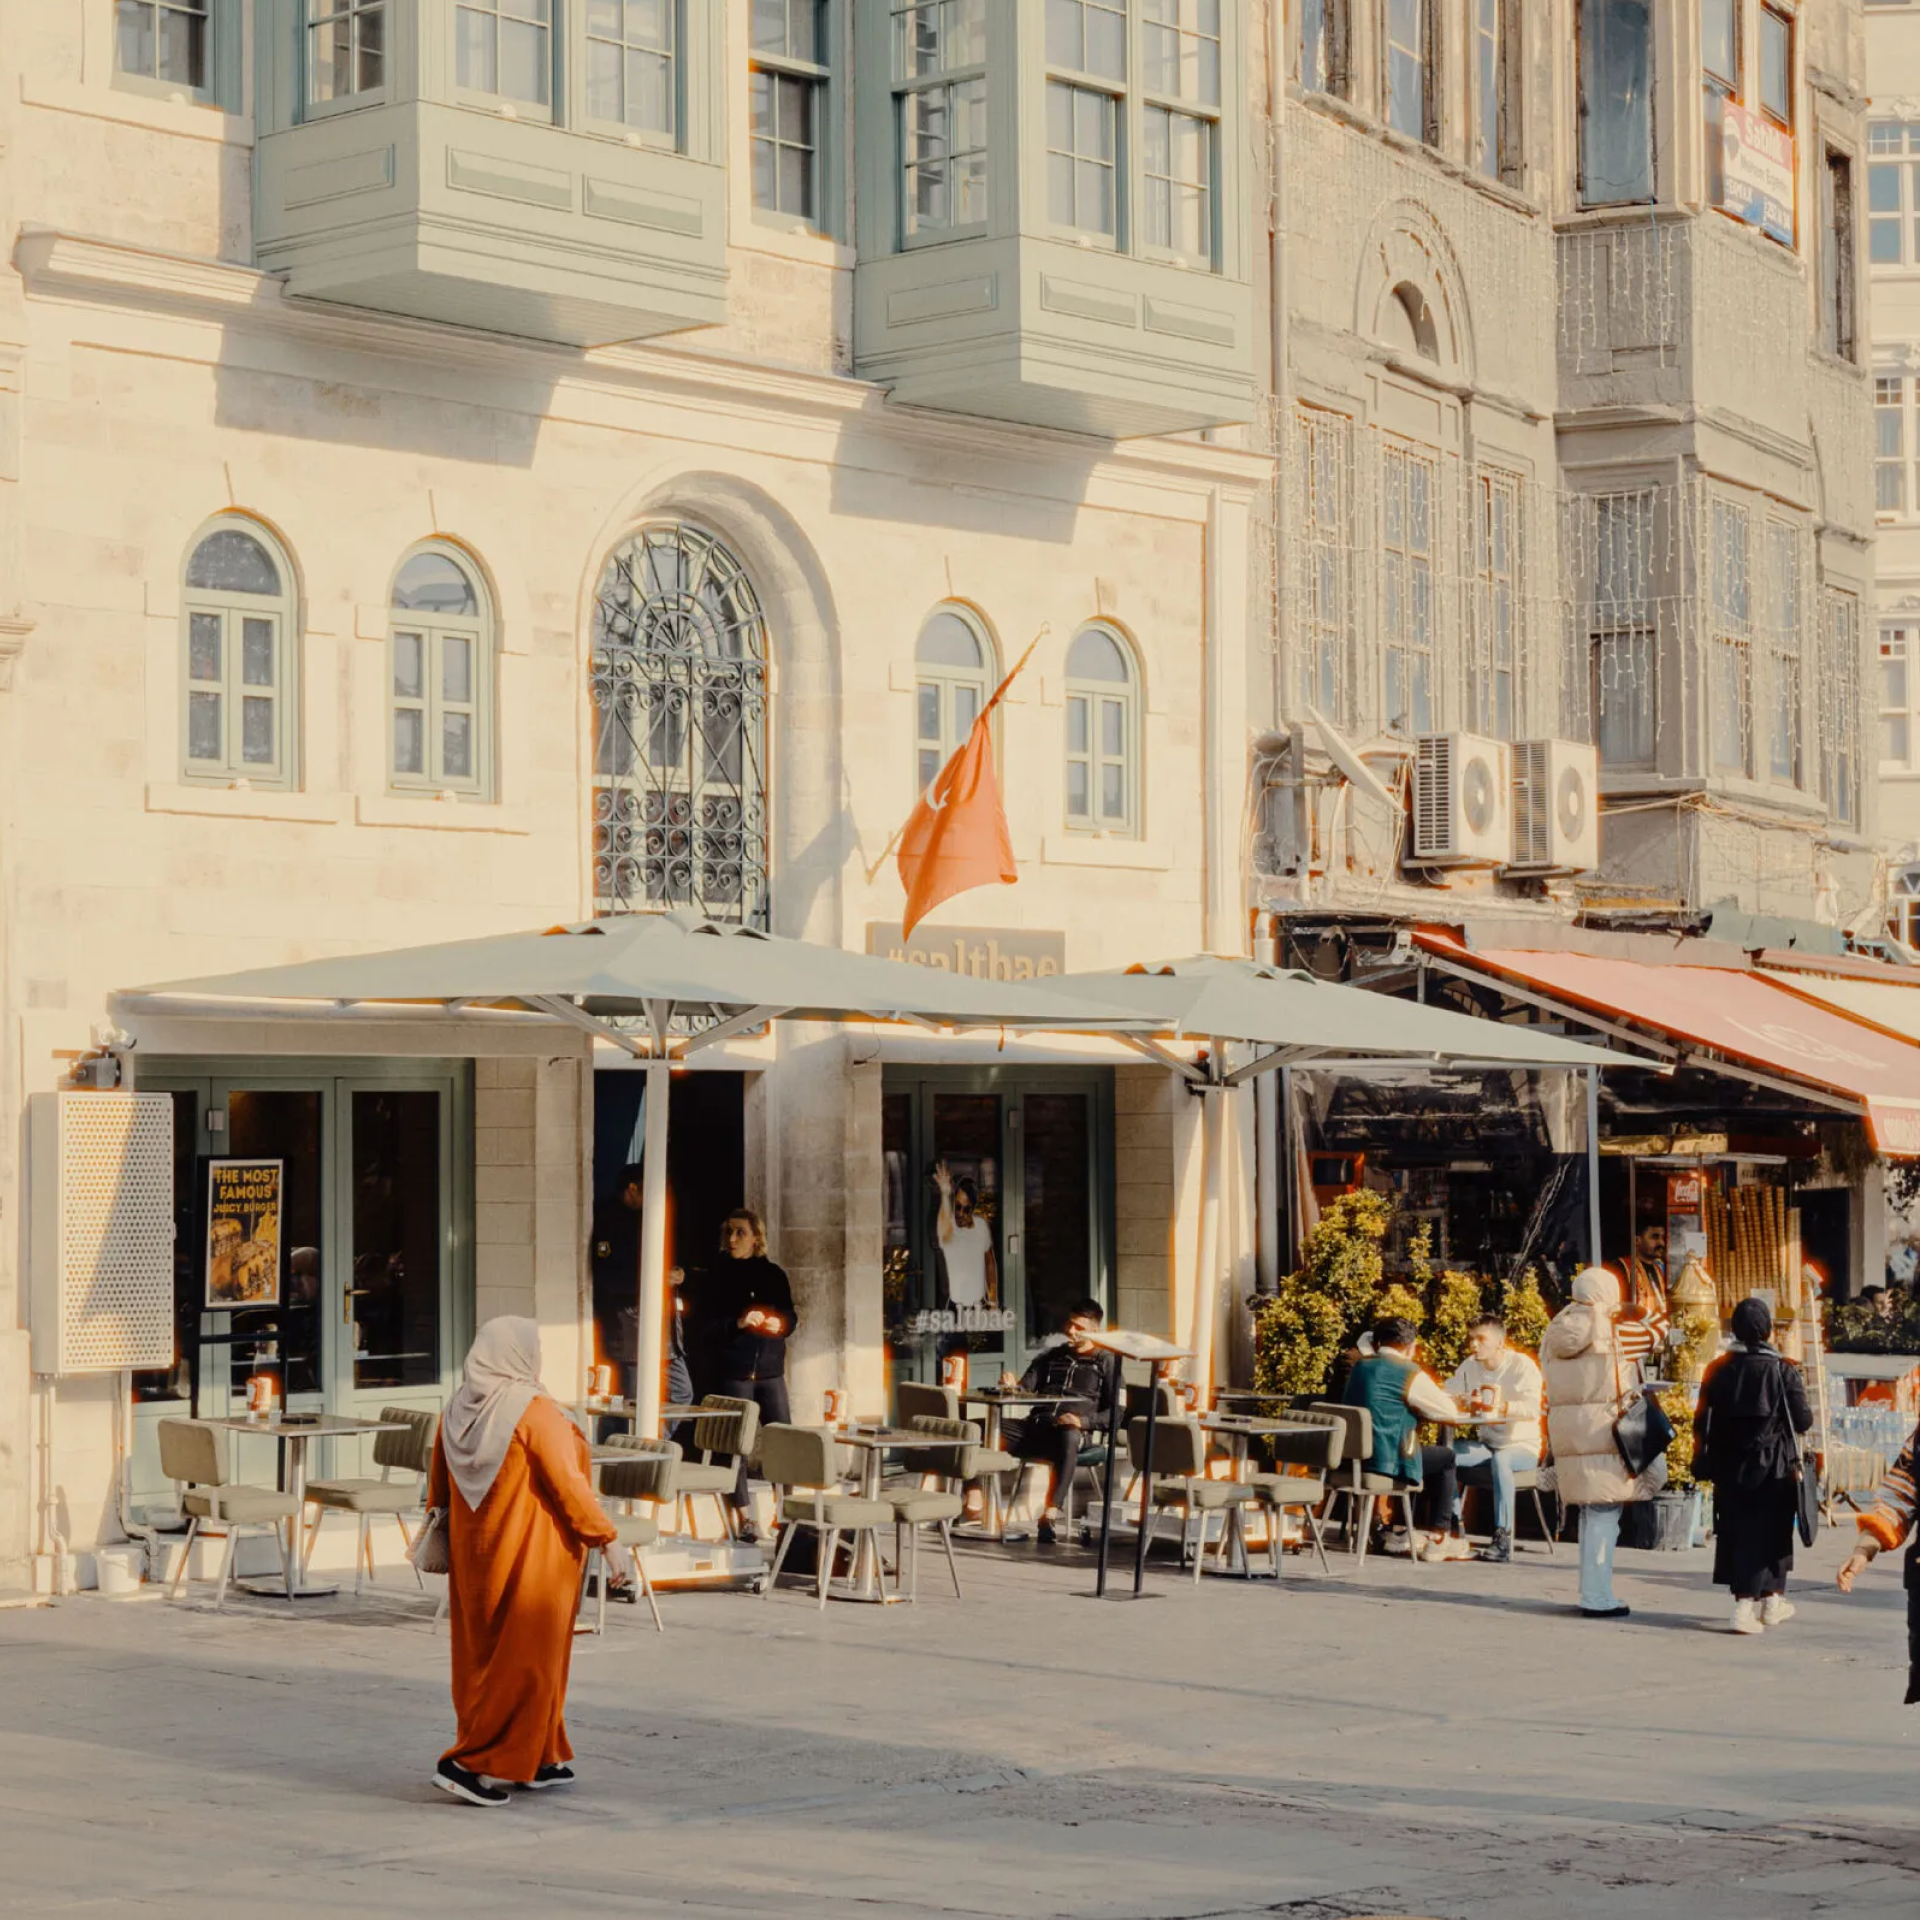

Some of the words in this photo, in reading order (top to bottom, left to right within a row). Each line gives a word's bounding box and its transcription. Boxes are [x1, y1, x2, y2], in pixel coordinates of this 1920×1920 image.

[214, 1168, 239, 1184] THE
[243, 1168, 278, 1183] MOST
[220, 1184, 272, 1200] FAMOUS
[213, 1203, 242, 1214] JUICY
[243, 1201, 277, 1213] BURGER
[916, 1302, 1016, 1334] #saltbae
